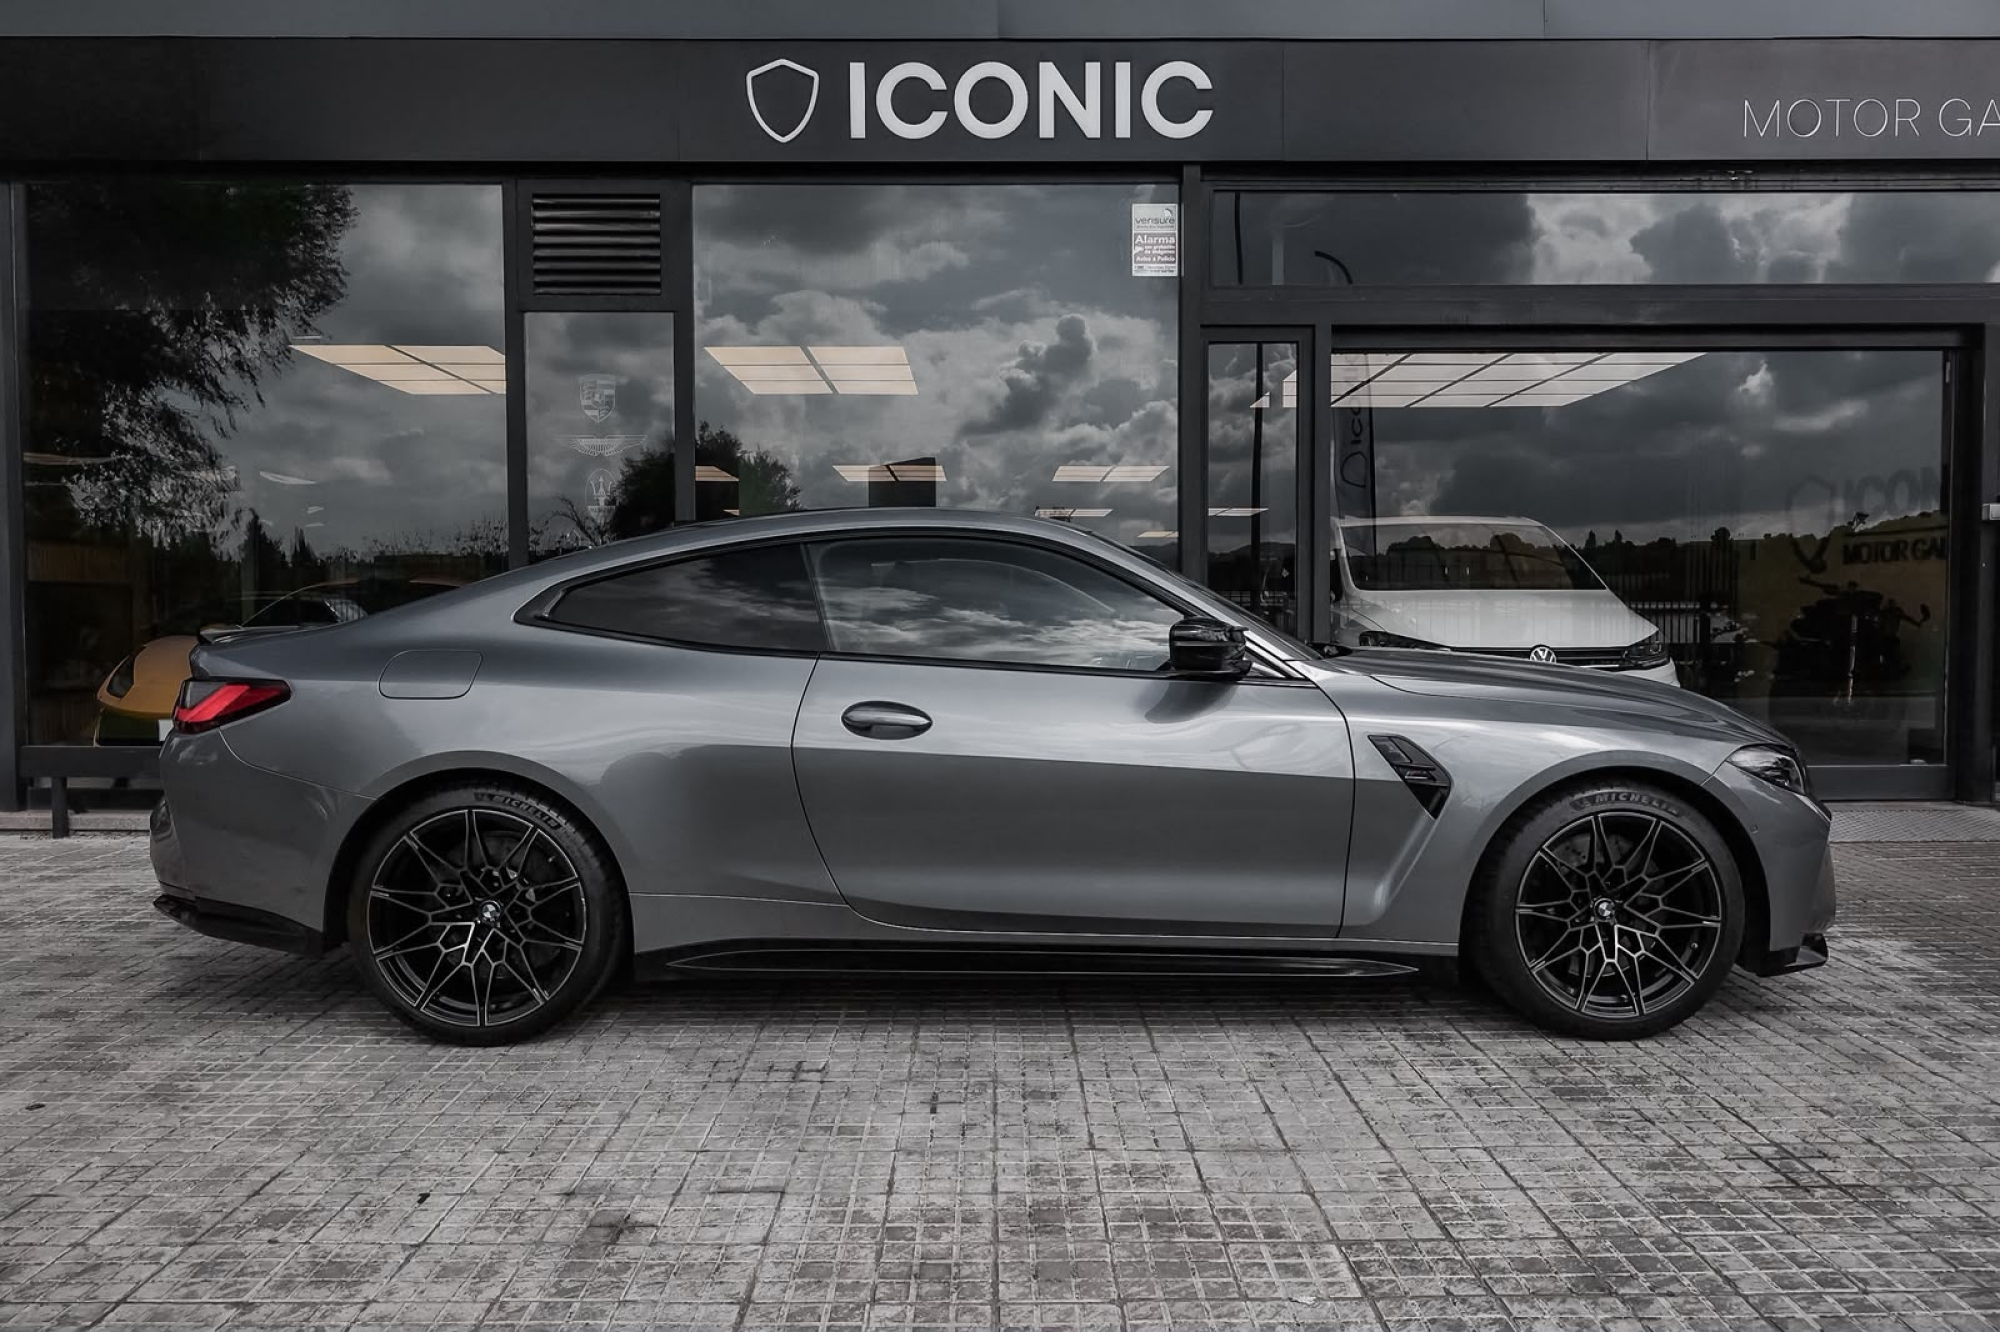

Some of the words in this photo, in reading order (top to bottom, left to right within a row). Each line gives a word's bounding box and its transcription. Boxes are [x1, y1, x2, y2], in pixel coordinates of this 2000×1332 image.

[849, 60, 1214, 140] ICONIC
[1743, 98, 1921, 138] MOTOR
[1135, 235, 1176, 244] Alarma
[1842, 539, 1908, 565] MOTOR
[1595, 791, 1680, 816] MICHELIN
